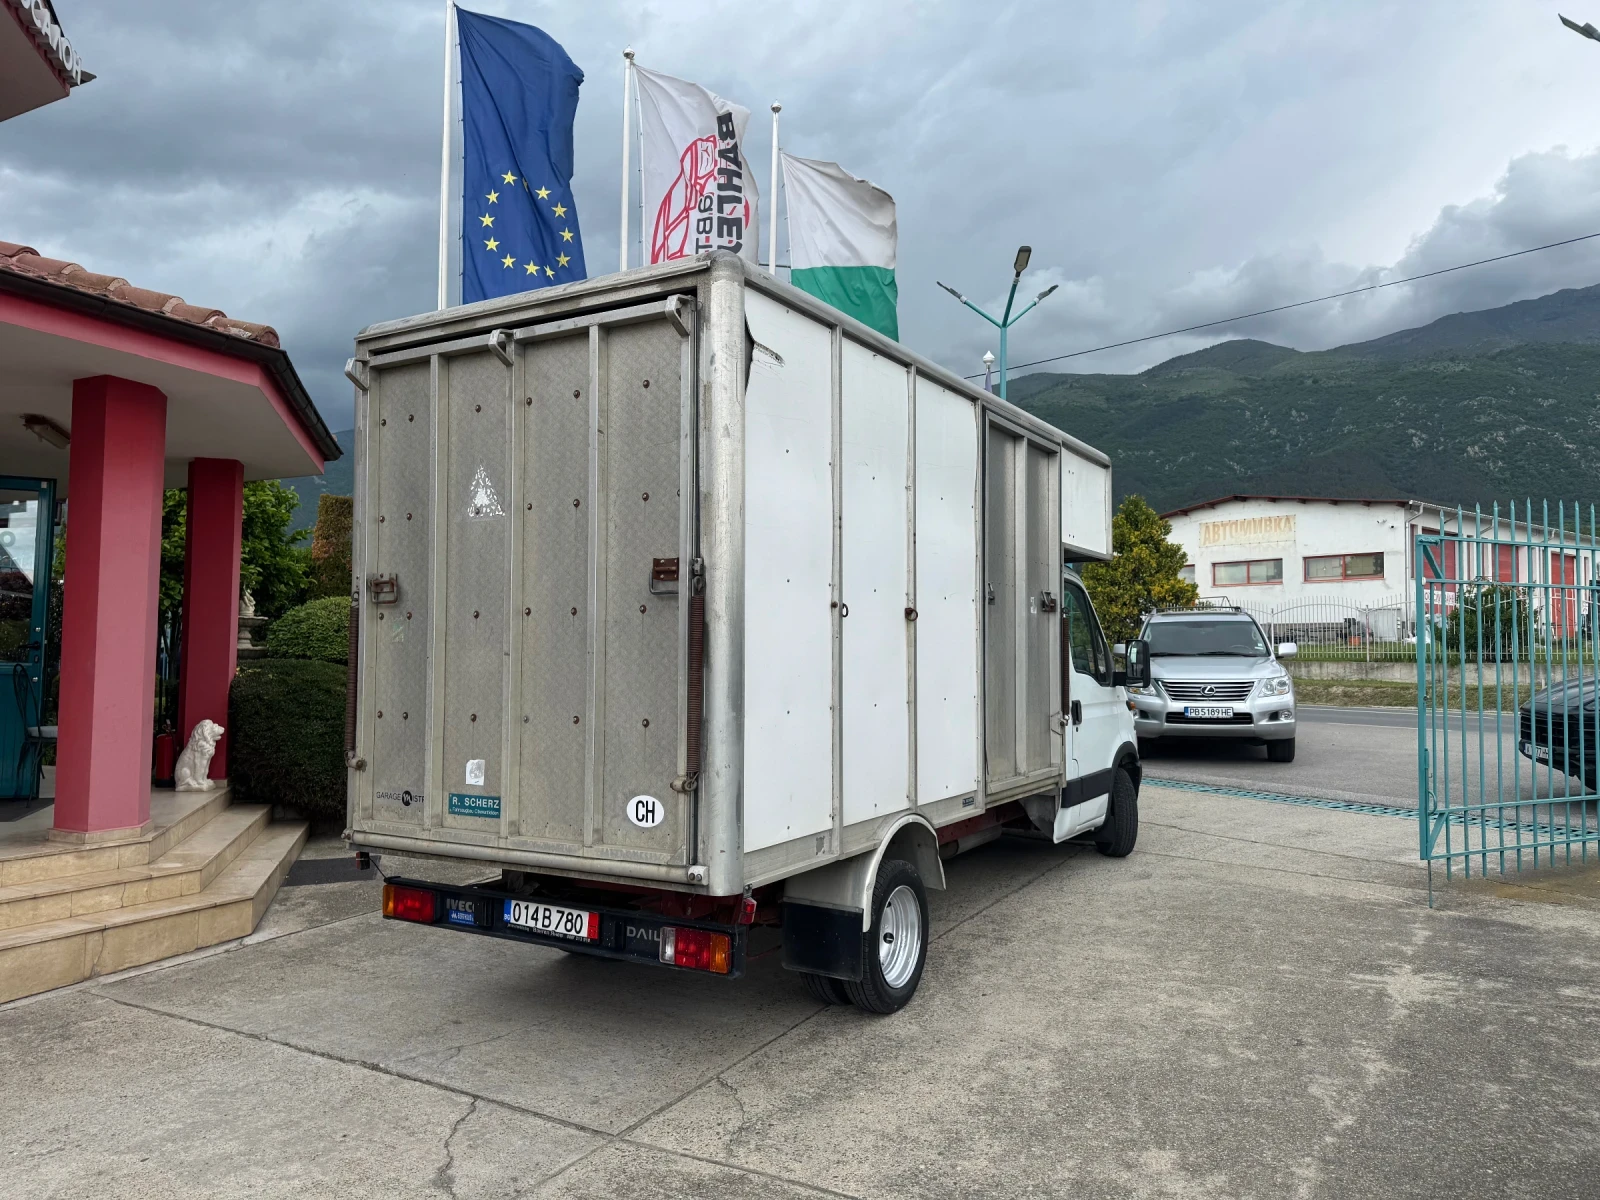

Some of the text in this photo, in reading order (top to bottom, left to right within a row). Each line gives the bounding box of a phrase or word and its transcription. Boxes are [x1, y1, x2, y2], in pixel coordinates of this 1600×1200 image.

[1203, 515, 1293, 546] АВТОМИВКА
[376, 791, 401, 801] GARAGE
[452, 796, 500, 809] R. SCHERZ
[635, 799, 656, 824] CH
